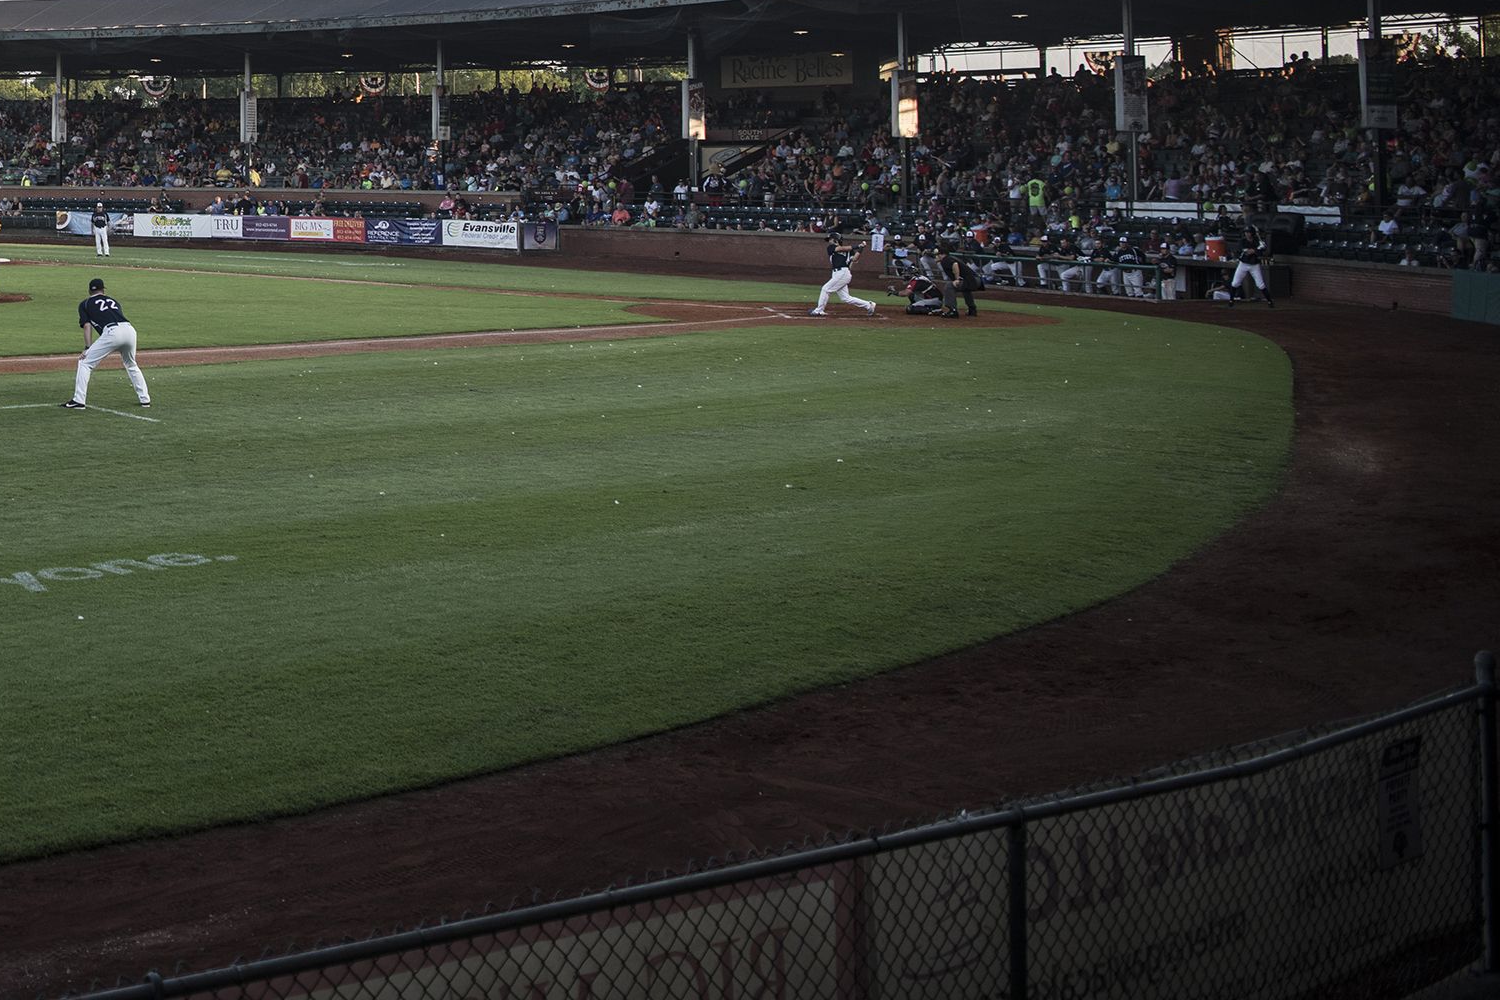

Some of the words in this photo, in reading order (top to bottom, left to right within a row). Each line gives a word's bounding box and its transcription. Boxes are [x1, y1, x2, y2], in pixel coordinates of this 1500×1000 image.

[732, 57, 787, 83] Racine
[795, 55, 843, 83] Belles
[214, 219, 239, 230] TRU
[295, 221, 308, 231] BIG
[462, 222, 516, 233] Evansville
[95, 298, 119, 311] 22
